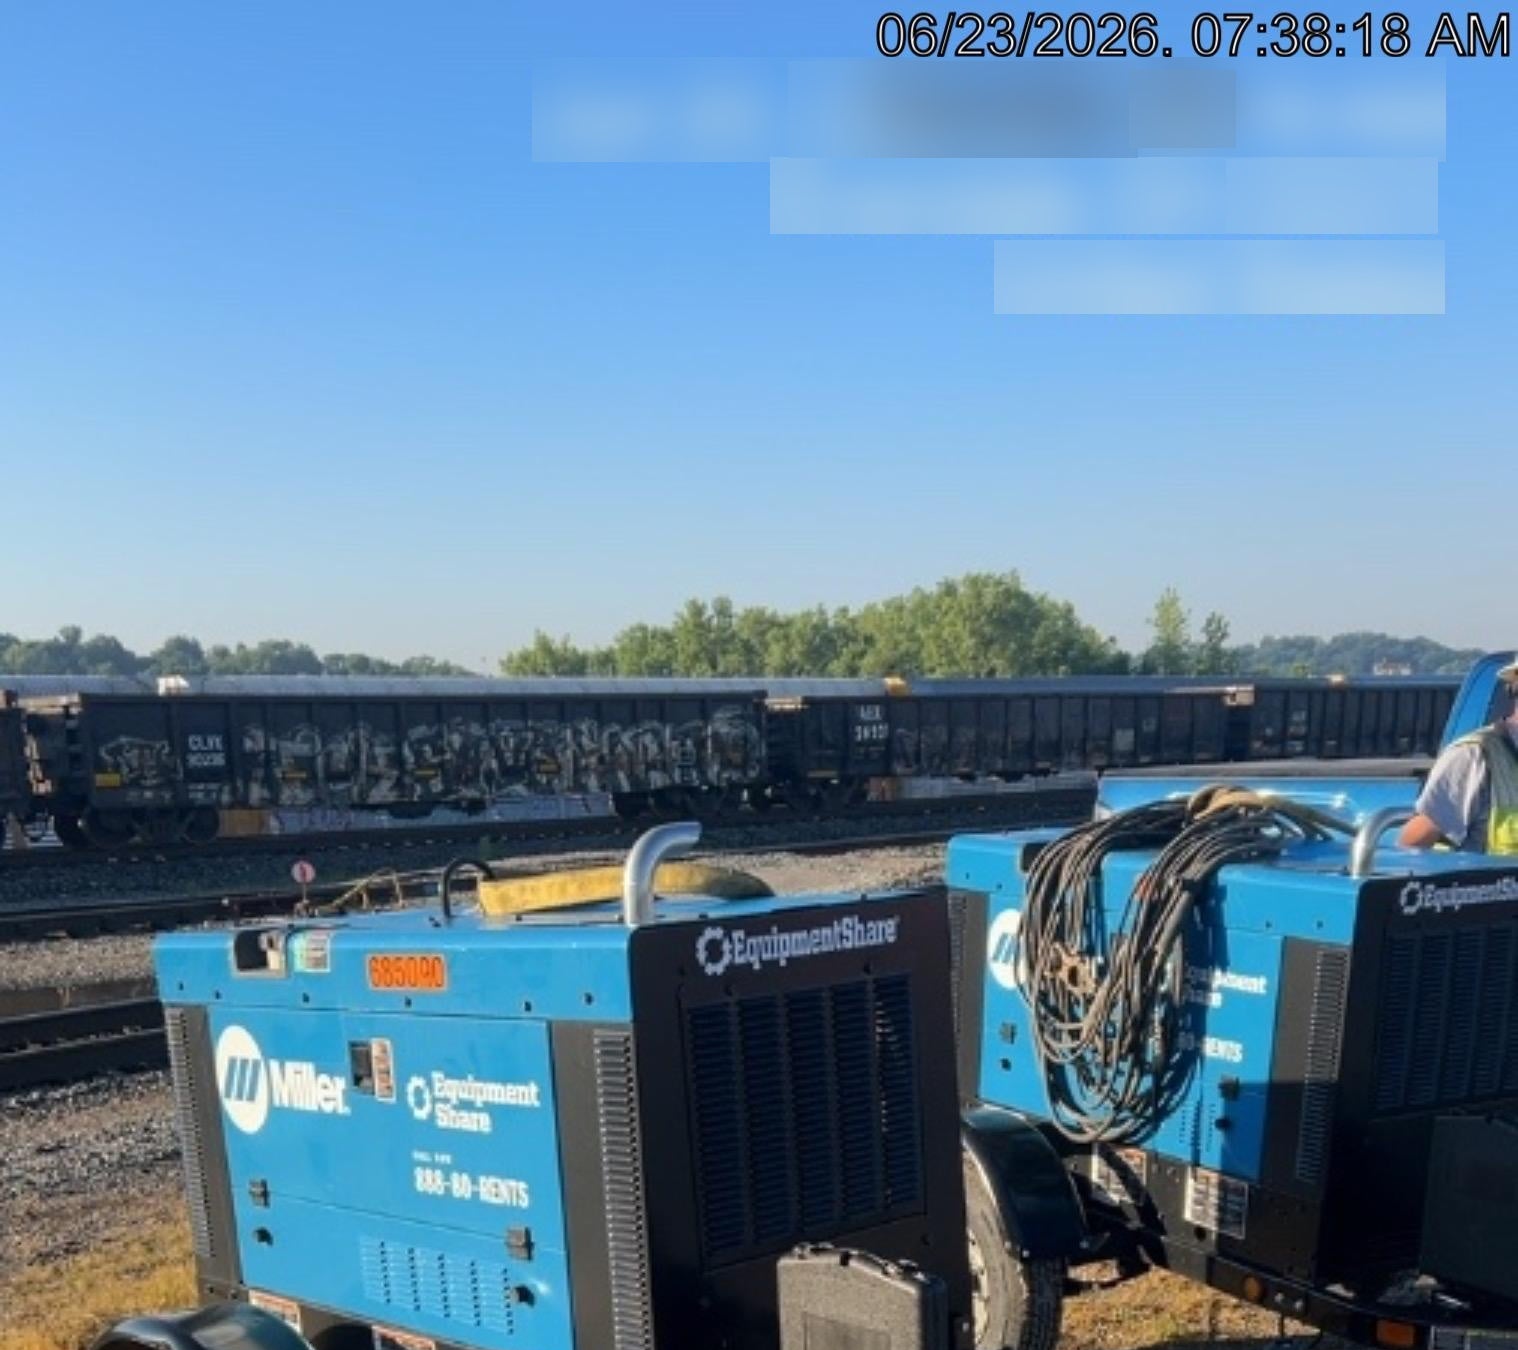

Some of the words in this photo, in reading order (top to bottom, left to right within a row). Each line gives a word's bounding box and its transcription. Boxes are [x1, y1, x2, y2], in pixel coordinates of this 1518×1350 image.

[731, 914, 897, 970] EquipmentShare
[368, 955, 445, 988] 685090
[269, 1059, 346, 1114] Miller
[431, 1070, 540, 1107] Equipment
[435, 1102, 493, 1132] Share
[413, 1166, 529, 1208] 888-80-RENTS
